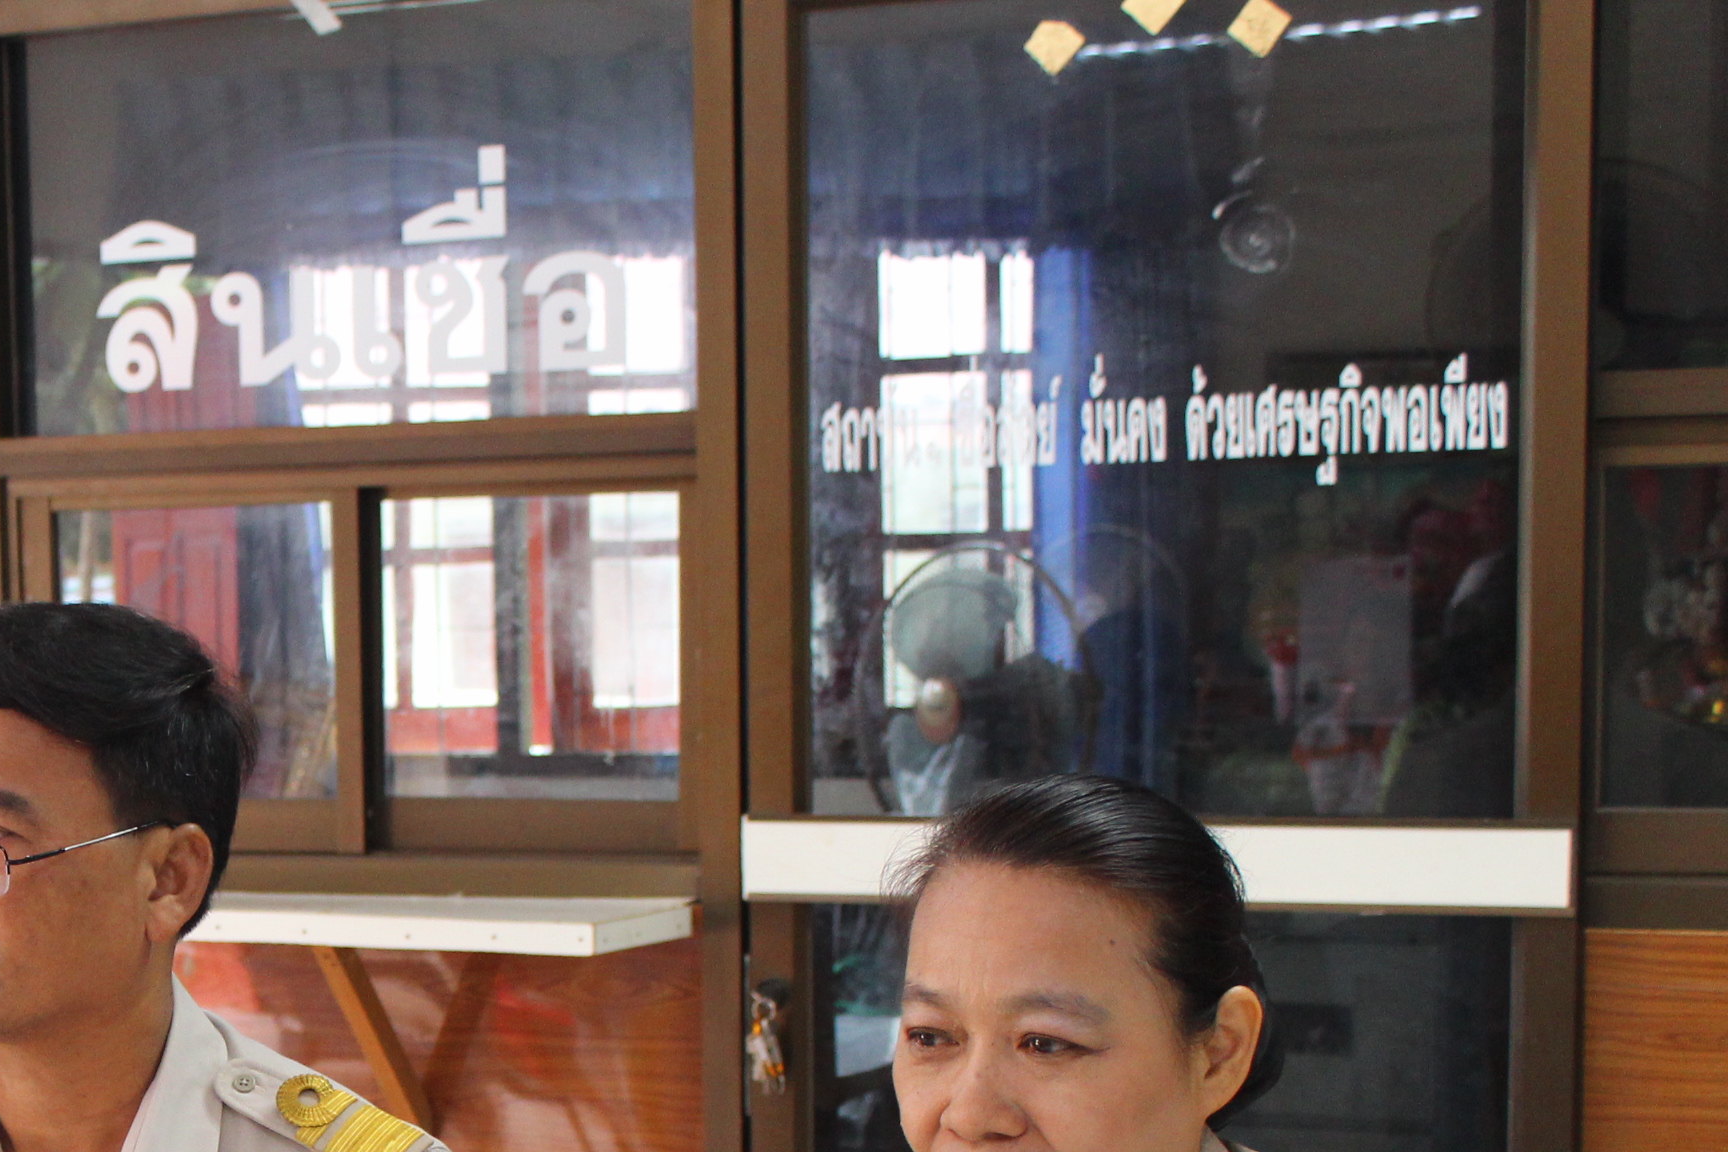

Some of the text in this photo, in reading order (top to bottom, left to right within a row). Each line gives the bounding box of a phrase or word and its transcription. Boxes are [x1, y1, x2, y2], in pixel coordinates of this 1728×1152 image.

[96, 144, 628, 393] สินเชื่อ
[1080, 353, 1167, 465] มั่นคง
[1185, 352, 1509, 486] ด้วยเศรษฐกิจพอเพียง
